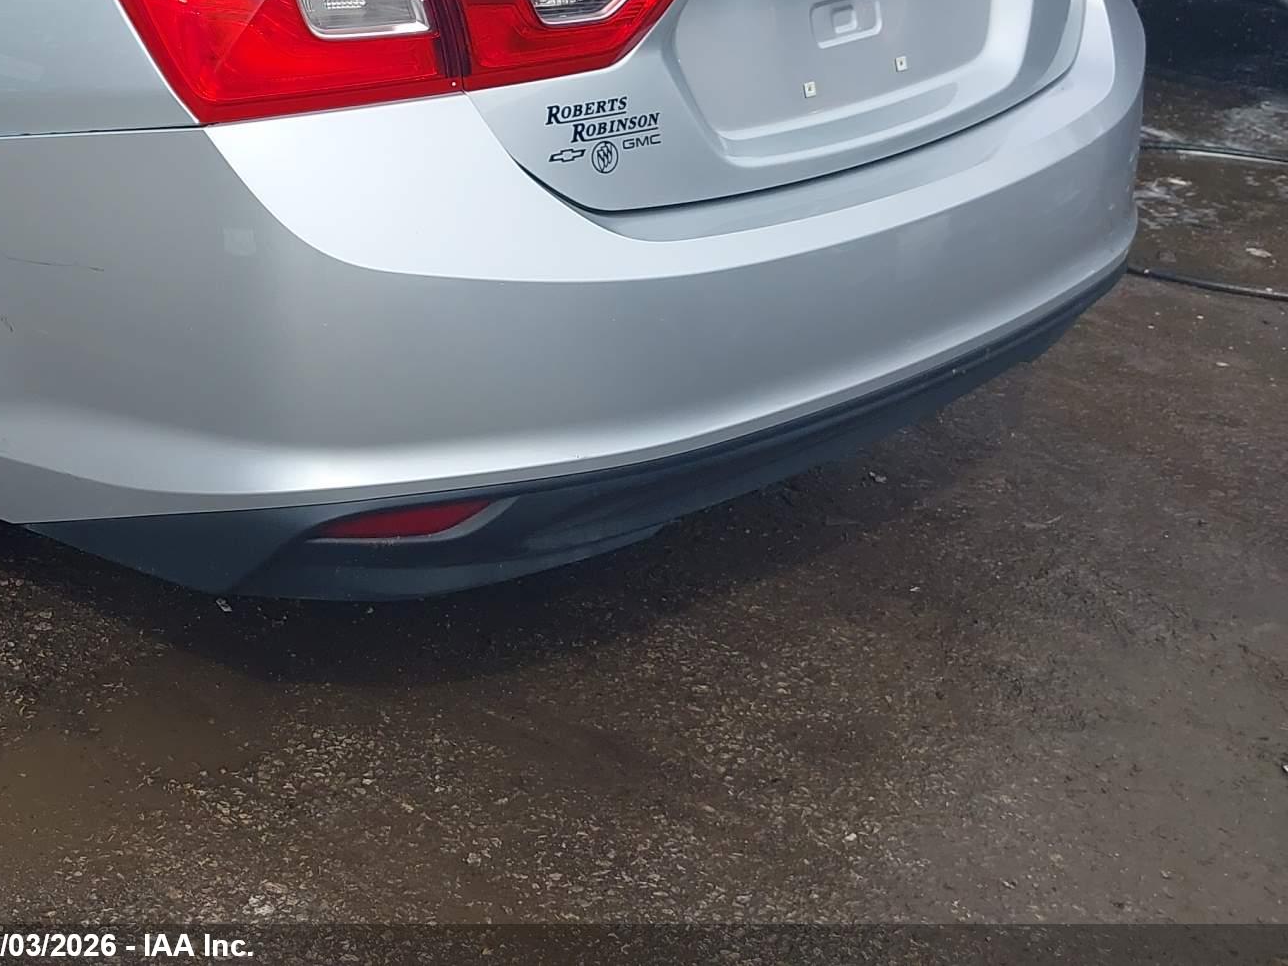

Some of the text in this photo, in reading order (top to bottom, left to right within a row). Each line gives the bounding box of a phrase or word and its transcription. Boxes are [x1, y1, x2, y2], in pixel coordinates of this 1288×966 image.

[545, 96, 628, 125] ROBERTS
[571, 112, 661, 143] ROBINSON
[622, 134, 662, 150] GMC
